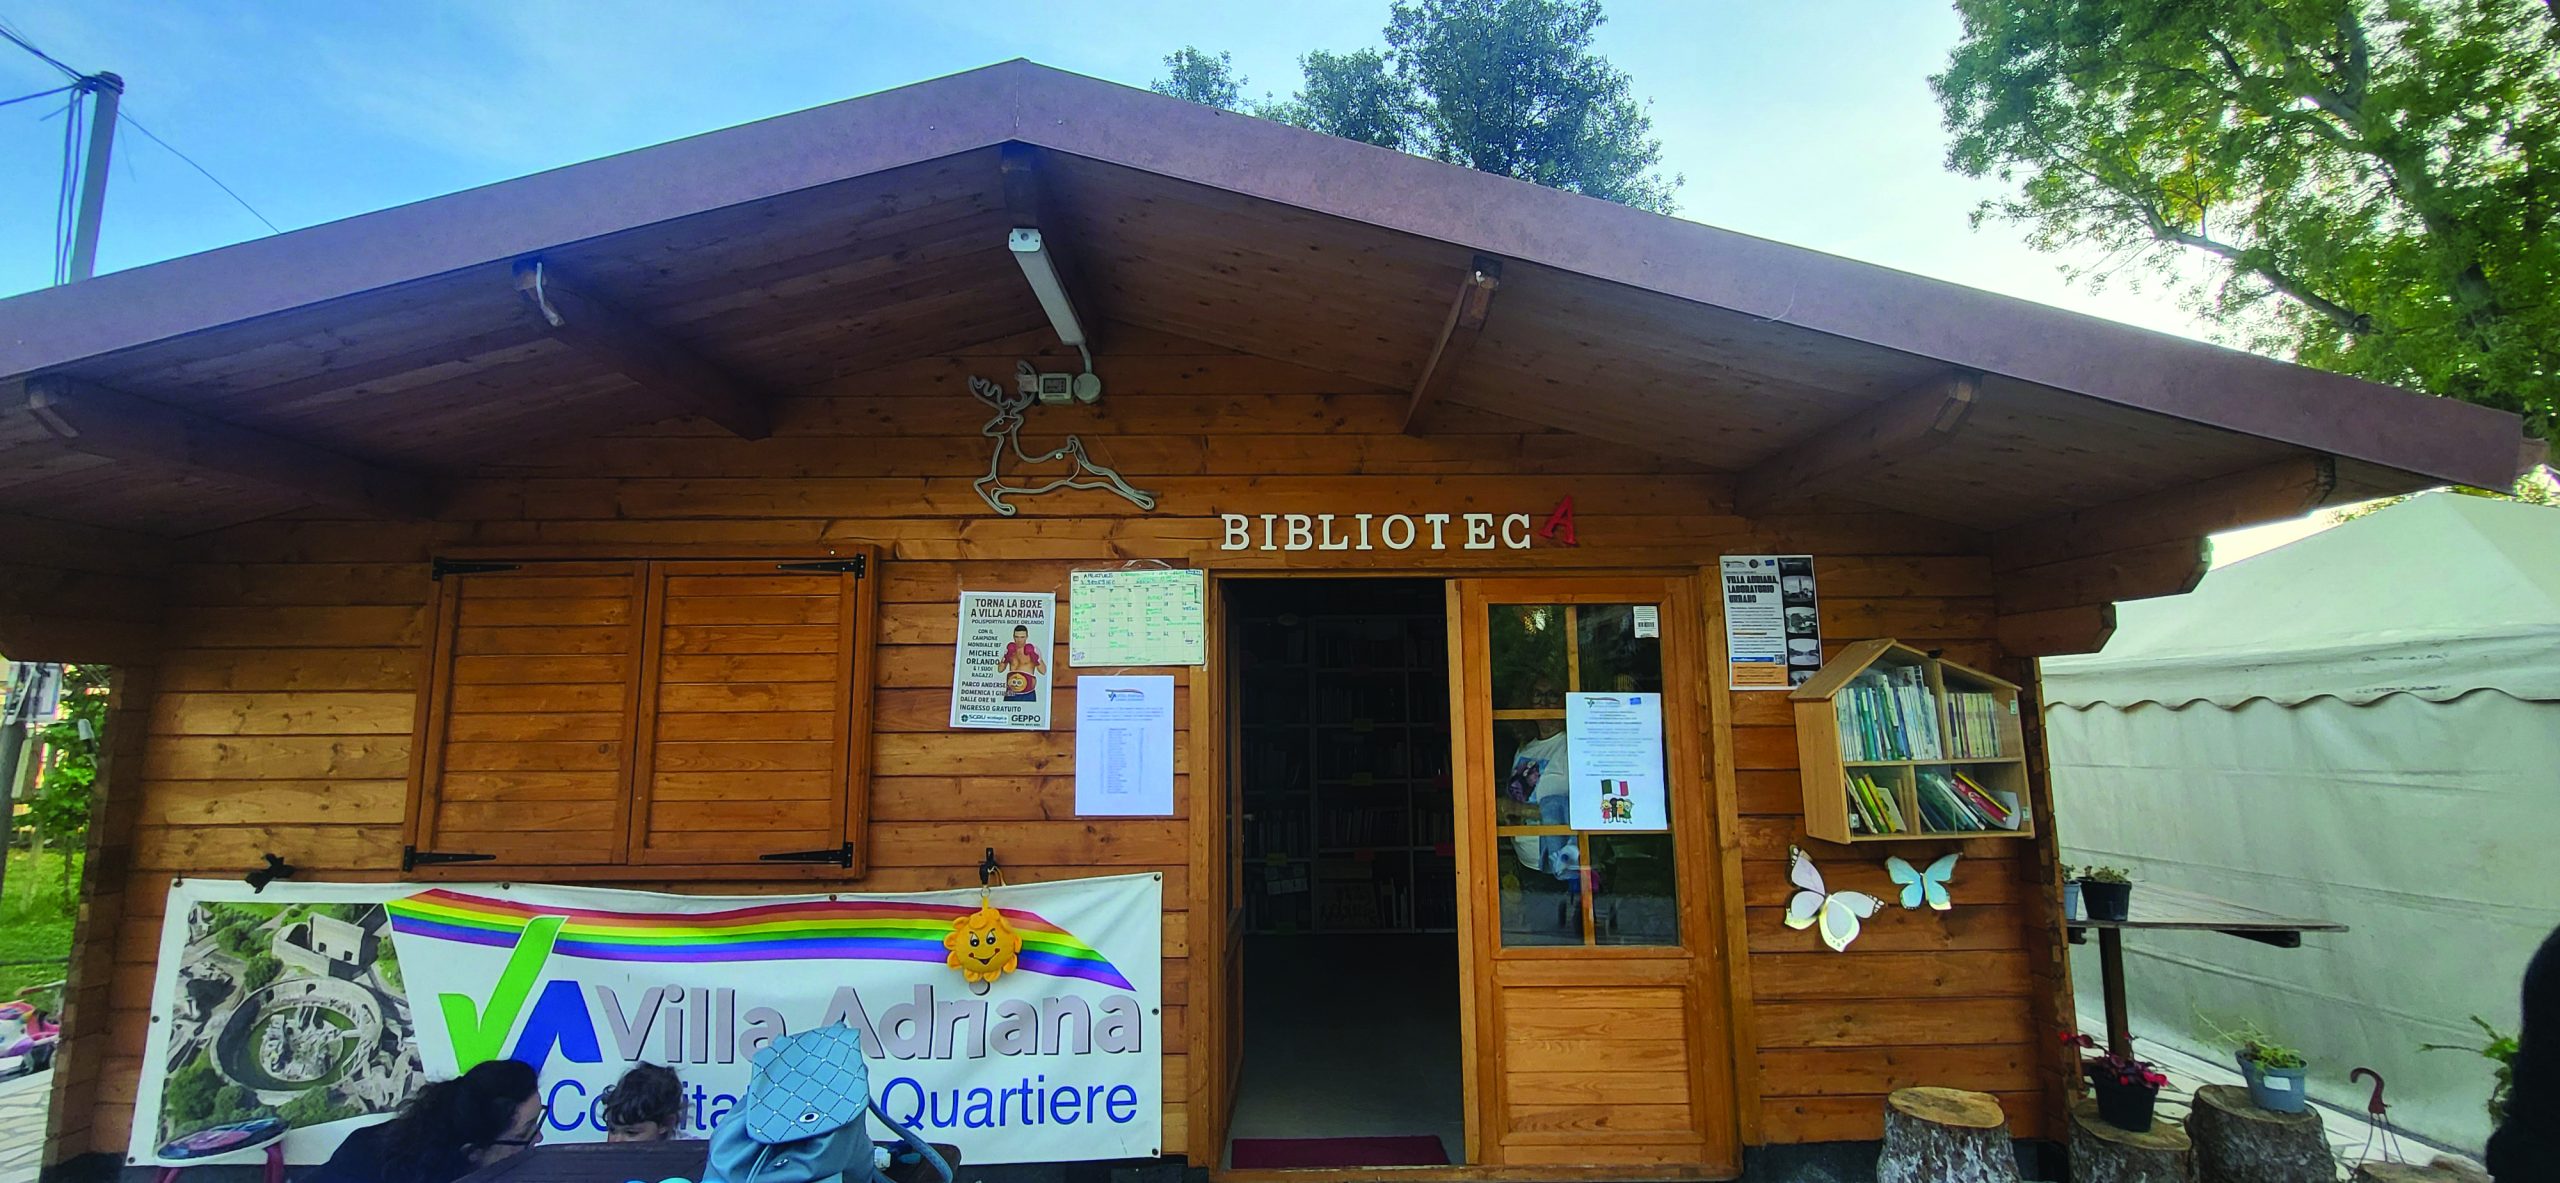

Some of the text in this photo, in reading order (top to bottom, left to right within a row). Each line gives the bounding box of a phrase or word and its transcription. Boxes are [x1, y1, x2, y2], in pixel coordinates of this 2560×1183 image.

[1220, 495, 1577, 550] BIBLIOTECA
[975, 598, 1043, 609] TORNA LA BOXE
[970, 608, 1045, 619] A VILLA ADRIANA
[966, 658, 1000, 666] ORLANDO
[959, 704, 1022, 713] INGRESSO GRATUITO
[1011, 714, 1041, 723] GEPPO
[595, 983, 1142, 1064] Villa Adriana
[881, 1075, 1137, 1129] Quartiere
